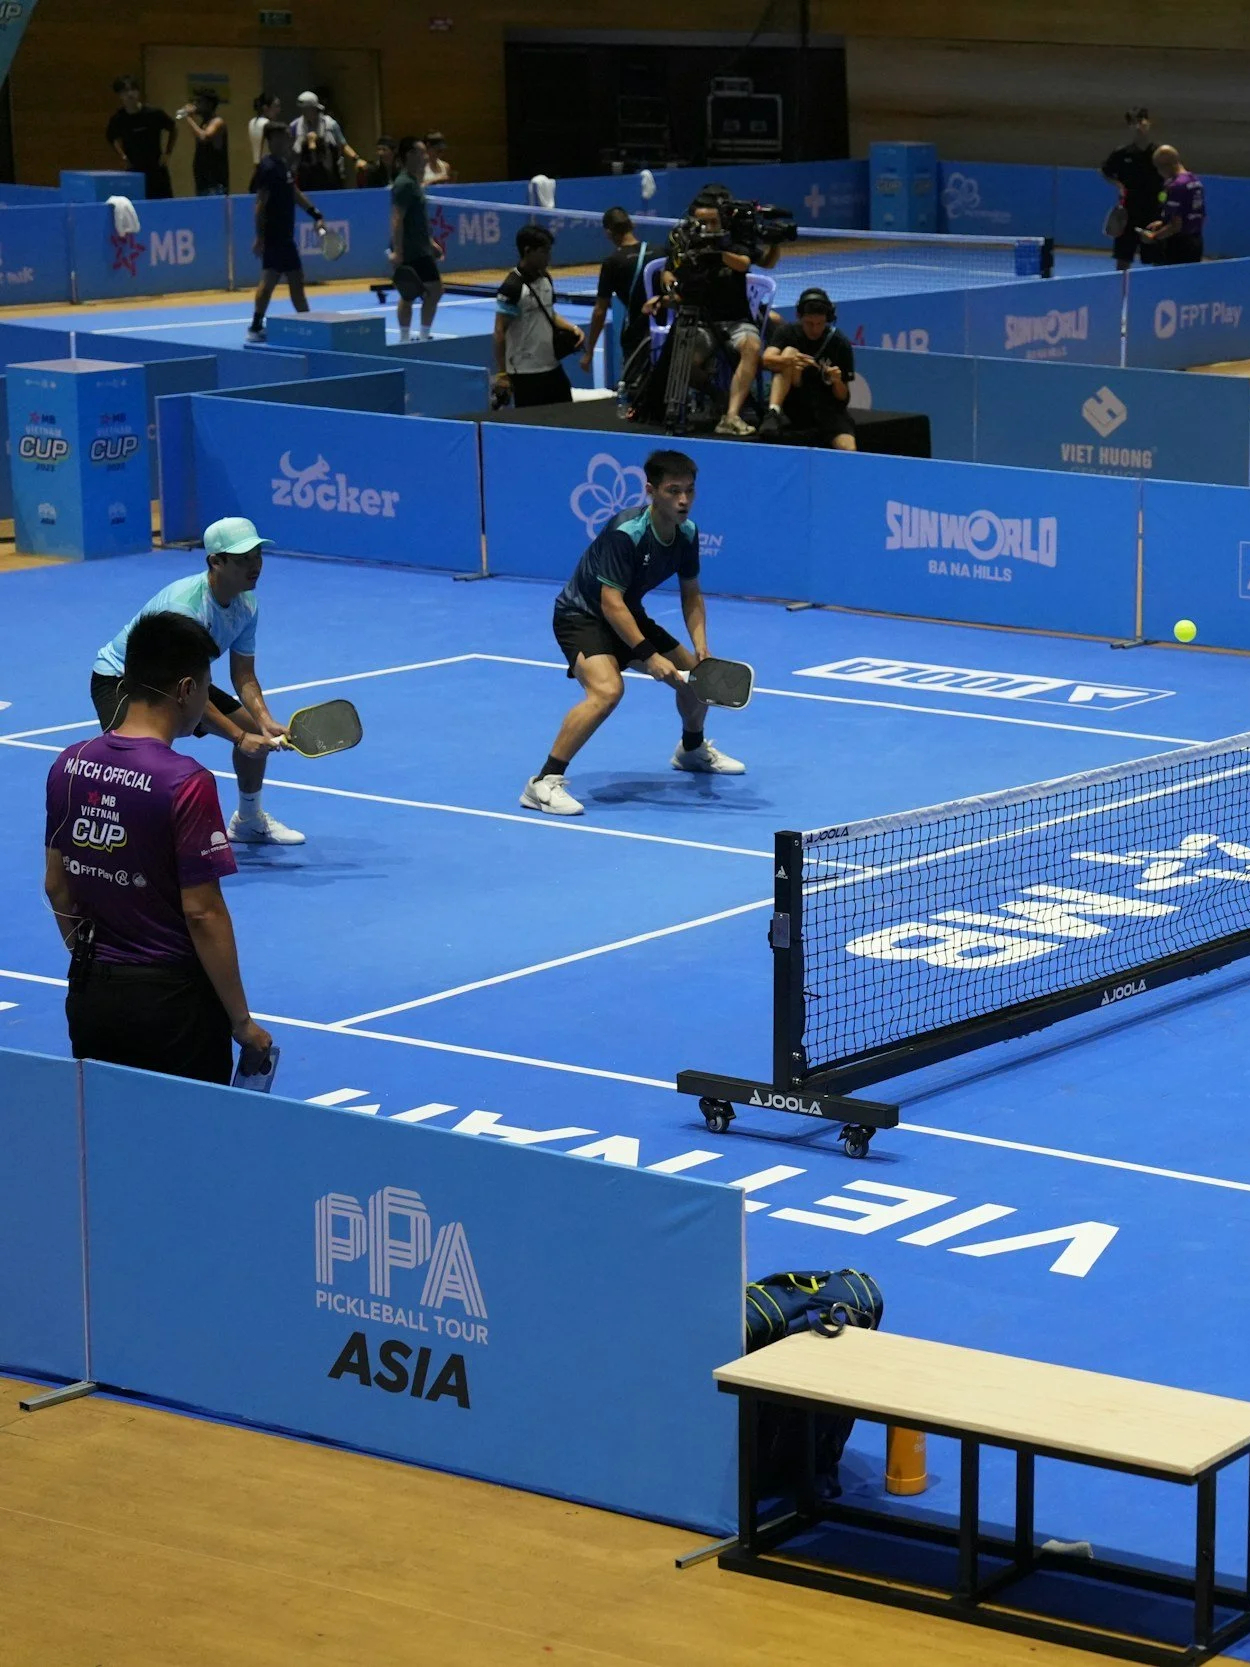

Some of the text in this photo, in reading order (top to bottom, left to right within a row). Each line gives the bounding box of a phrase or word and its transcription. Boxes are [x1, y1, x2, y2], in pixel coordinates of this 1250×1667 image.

[458, 212, 500, 245] MB
[151, 229, 195, 266] MB
[1180, 301, 1242, 329] FPT Play
[41, 413, 56, 425] MB
[19, 436, 68, 461] CUP
[90, 436, 138, 461] CUP
[1061, 443, 1153, 469] VIET HUONG
[928, 559, 1012, 582] BA NA HILLS
[64, 757, 152, 792] MATCH OFFICIAL
[80, 805, 120, 823] VIETNAM
[101, 795, 116, 808] MB
[72, 818, 125, 852] CUP
[814, 826, 849, 843] JOOLA
[98, 867, 114, 883] Play
[845, 884, 1181, 970] MB
[1110, 979, 1147, 1003] JOOLA
[763, 1093, 823, 1115] JOOLA
[315, 1186, 488, 1319] PPA
[316, 1289, 489, 1345] PICKLEBALL TOUR
[327, 1331, 471, 1410] ASIA
